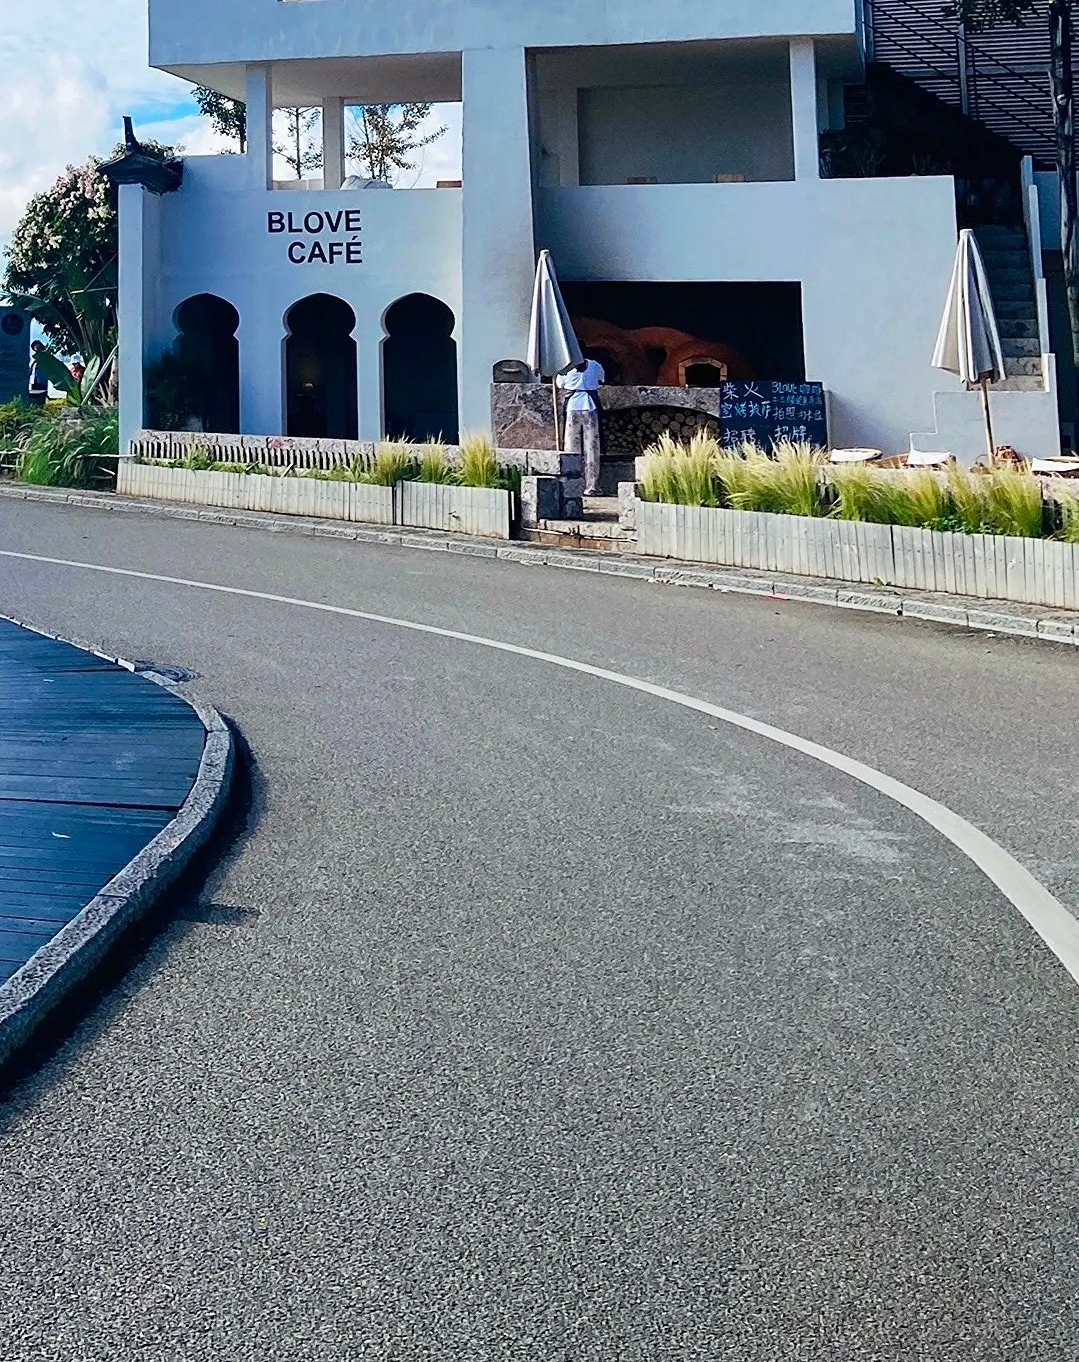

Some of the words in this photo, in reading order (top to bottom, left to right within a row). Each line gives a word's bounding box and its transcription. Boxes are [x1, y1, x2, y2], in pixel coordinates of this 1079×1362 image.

[268, 210, 361, 234] BLOVE
[288, 235, 362, 264] CAFÉ
[723, 381, 764, 400] 柴火
